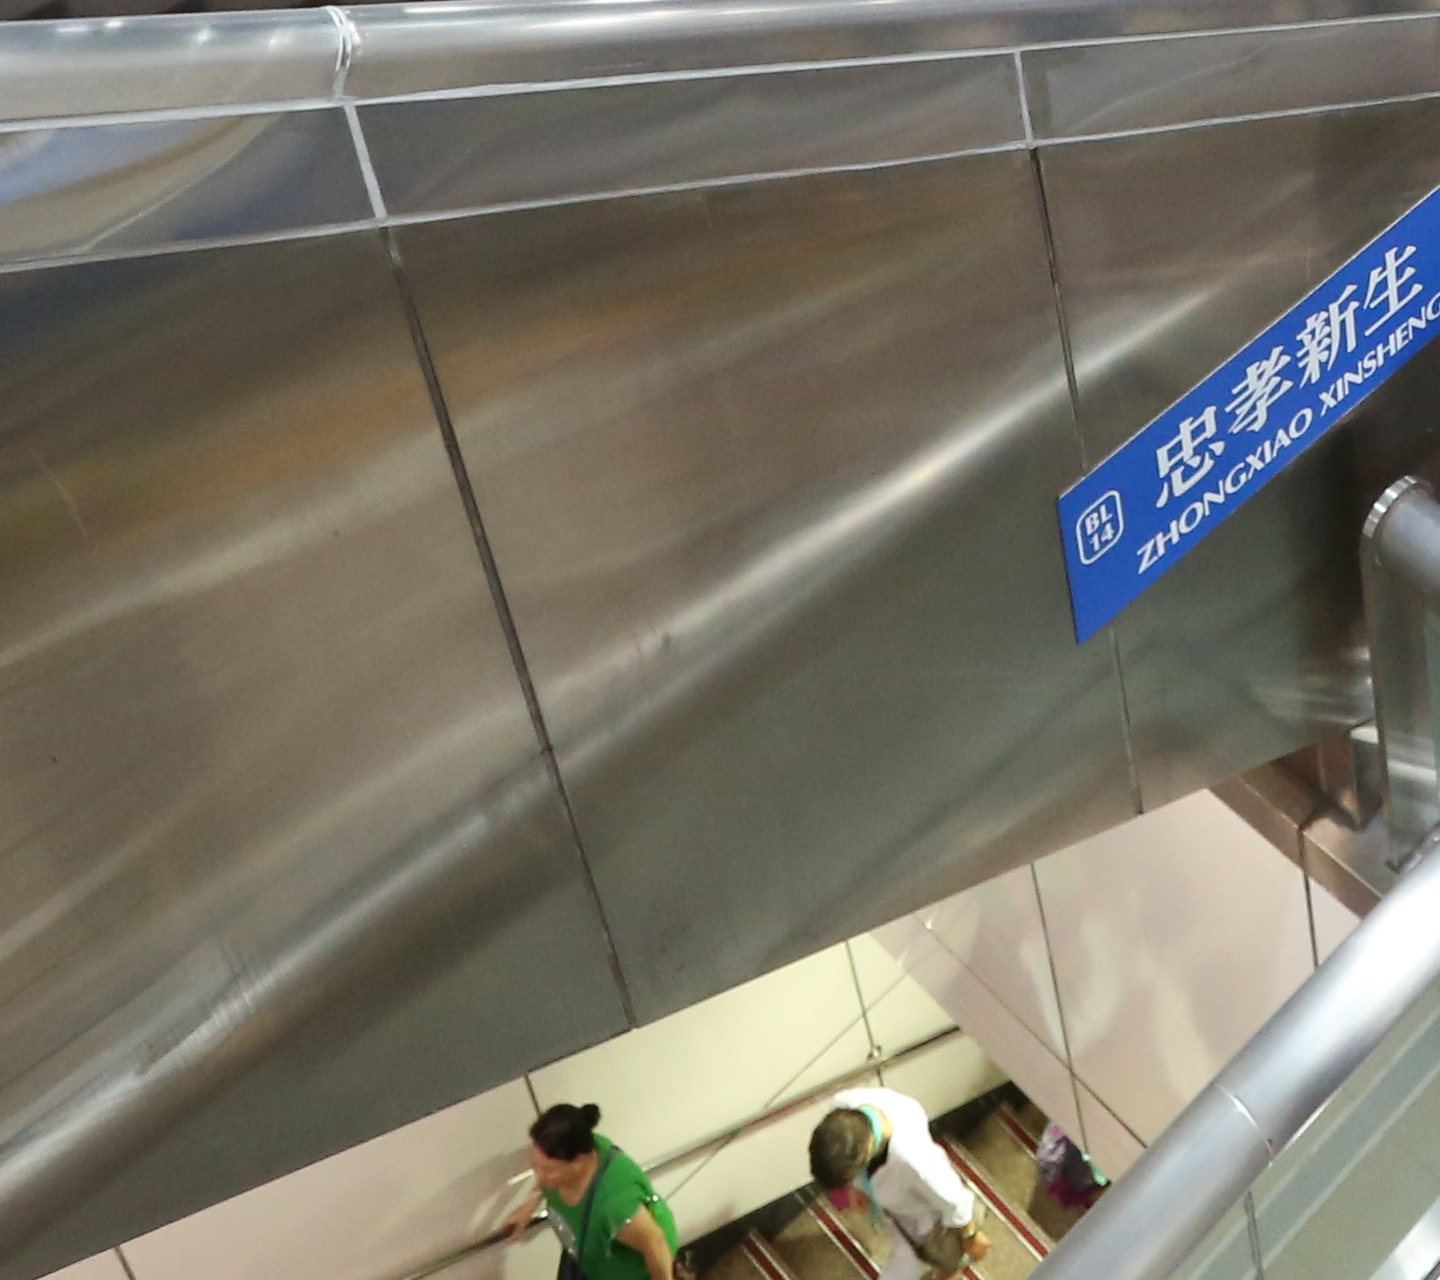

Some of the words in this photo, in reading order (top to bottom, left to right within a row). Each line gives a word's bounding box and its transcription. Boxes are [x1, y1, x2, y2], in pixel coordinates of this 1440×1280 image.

[1156, 244, 1424, 509] 忠孝新生
[1085, 504, 1113, 534] BL
[1089, 525, 1115, 553] 14
[1136, 407, 1314, 575] ZHONGXIAO
